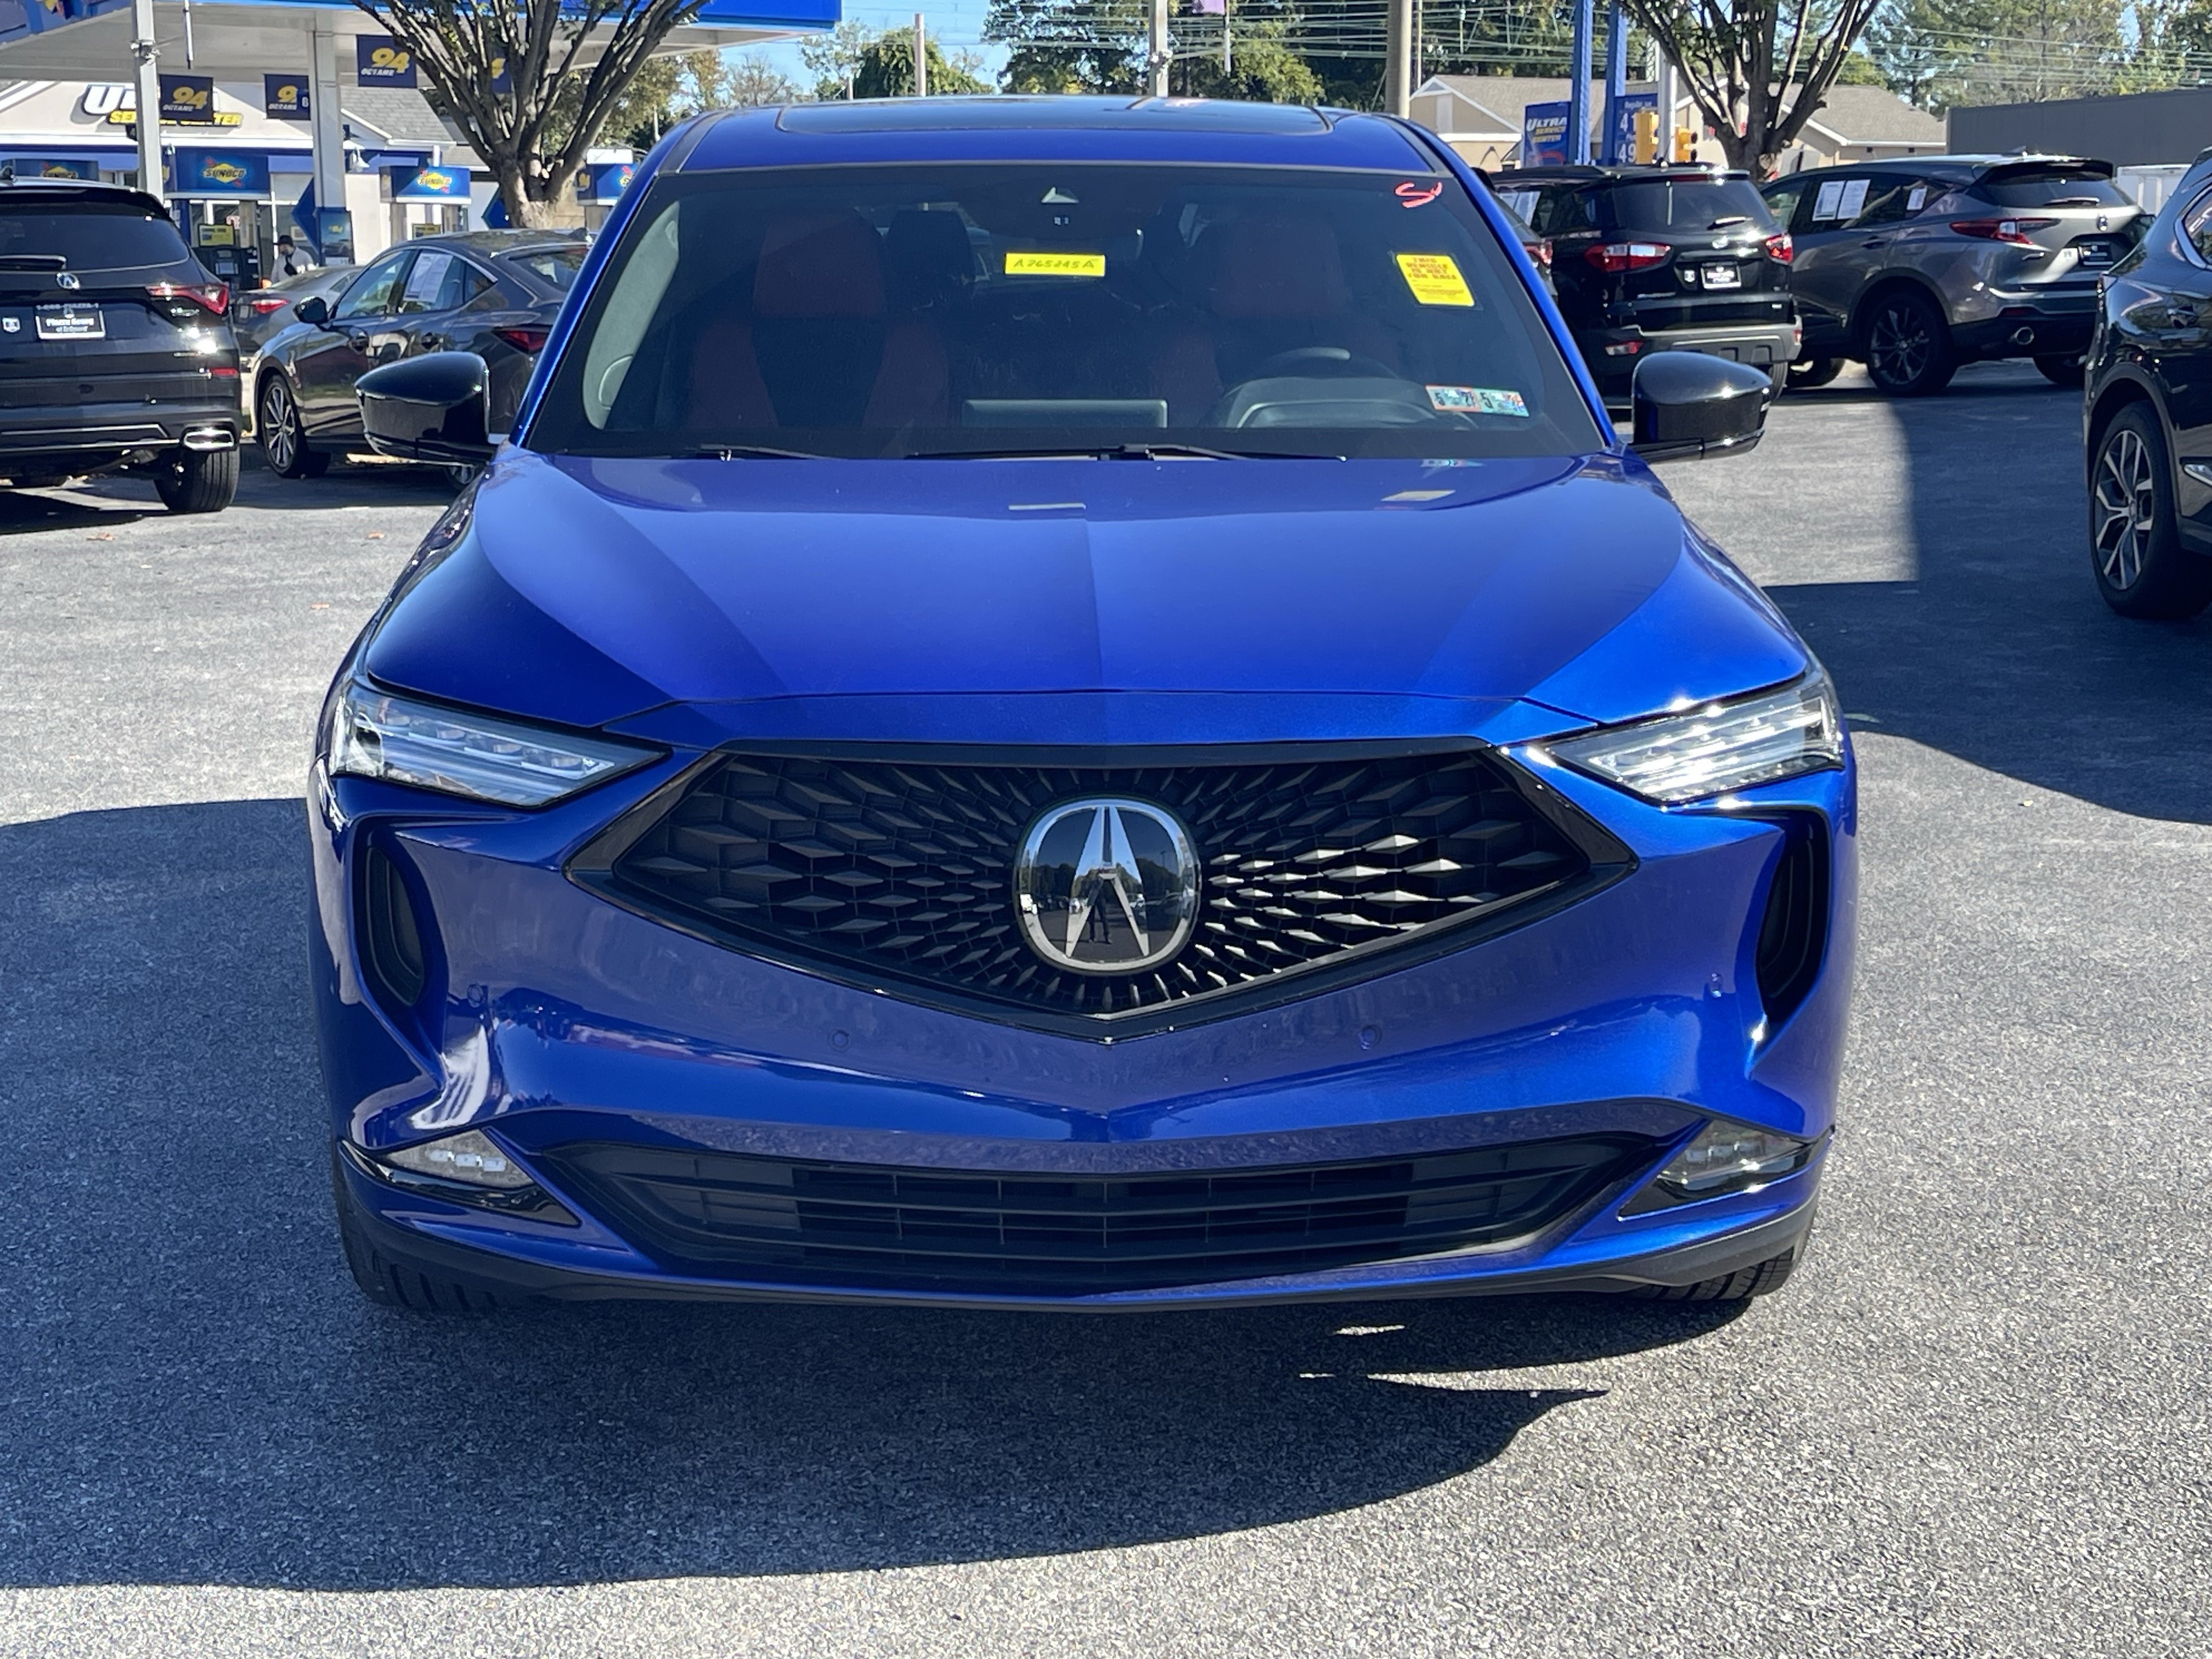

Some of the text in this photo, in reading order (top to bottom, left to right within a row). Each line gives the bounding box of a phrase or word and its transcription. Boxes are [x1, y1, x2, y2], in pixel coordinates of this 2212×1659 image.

[372, 48, 410, 74] 94
[173, 86, 207, 109] 94
[278, 86, 297, 103] 9
[1526, 116, 1568, 132] ULTRA
[1620, 112, 1637, 132] 41
[1618, 143, 1637, 163] 49
[205, 168, 245, 178] SUNOCO
